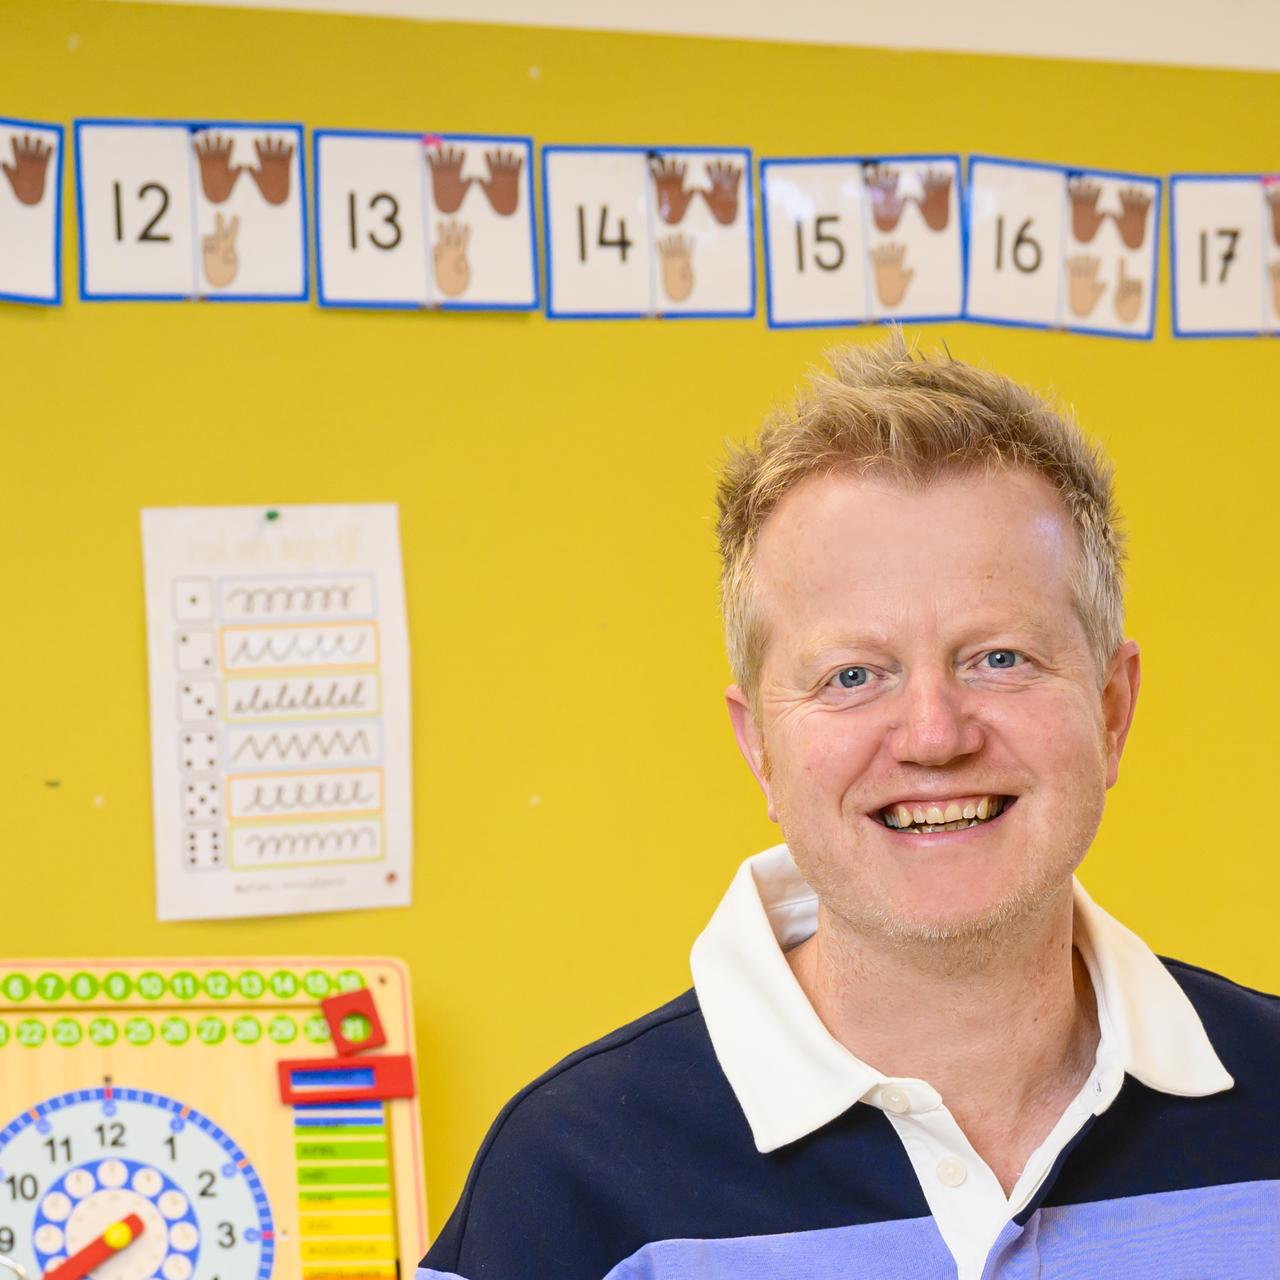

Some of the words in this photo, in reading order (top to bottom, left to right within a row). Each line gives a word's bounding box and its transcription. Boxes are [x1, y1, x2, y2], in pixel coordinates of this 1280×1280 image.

[114, 181, 172, 243] 12
[348, 192, 403, 251] 13
[576, 205, 633, 264] 14
[795, 216, 847, 273] 15
[994, 217, 1043, 273] 16
[1197, 229, 1241, 287] 17
[21, 1026, 42, 1041] 22
[92, 1024, 115, 1039] 24
[95, 1123, 127, 1147] 12
[165, 1136, 177, 1161] 1
[44, 1138, 73, 1163] 11
[5, 1174, 38, 1200] 10
[199, 1171, 216, 1198] 2
[217, 1222, 236, 1249] 3
